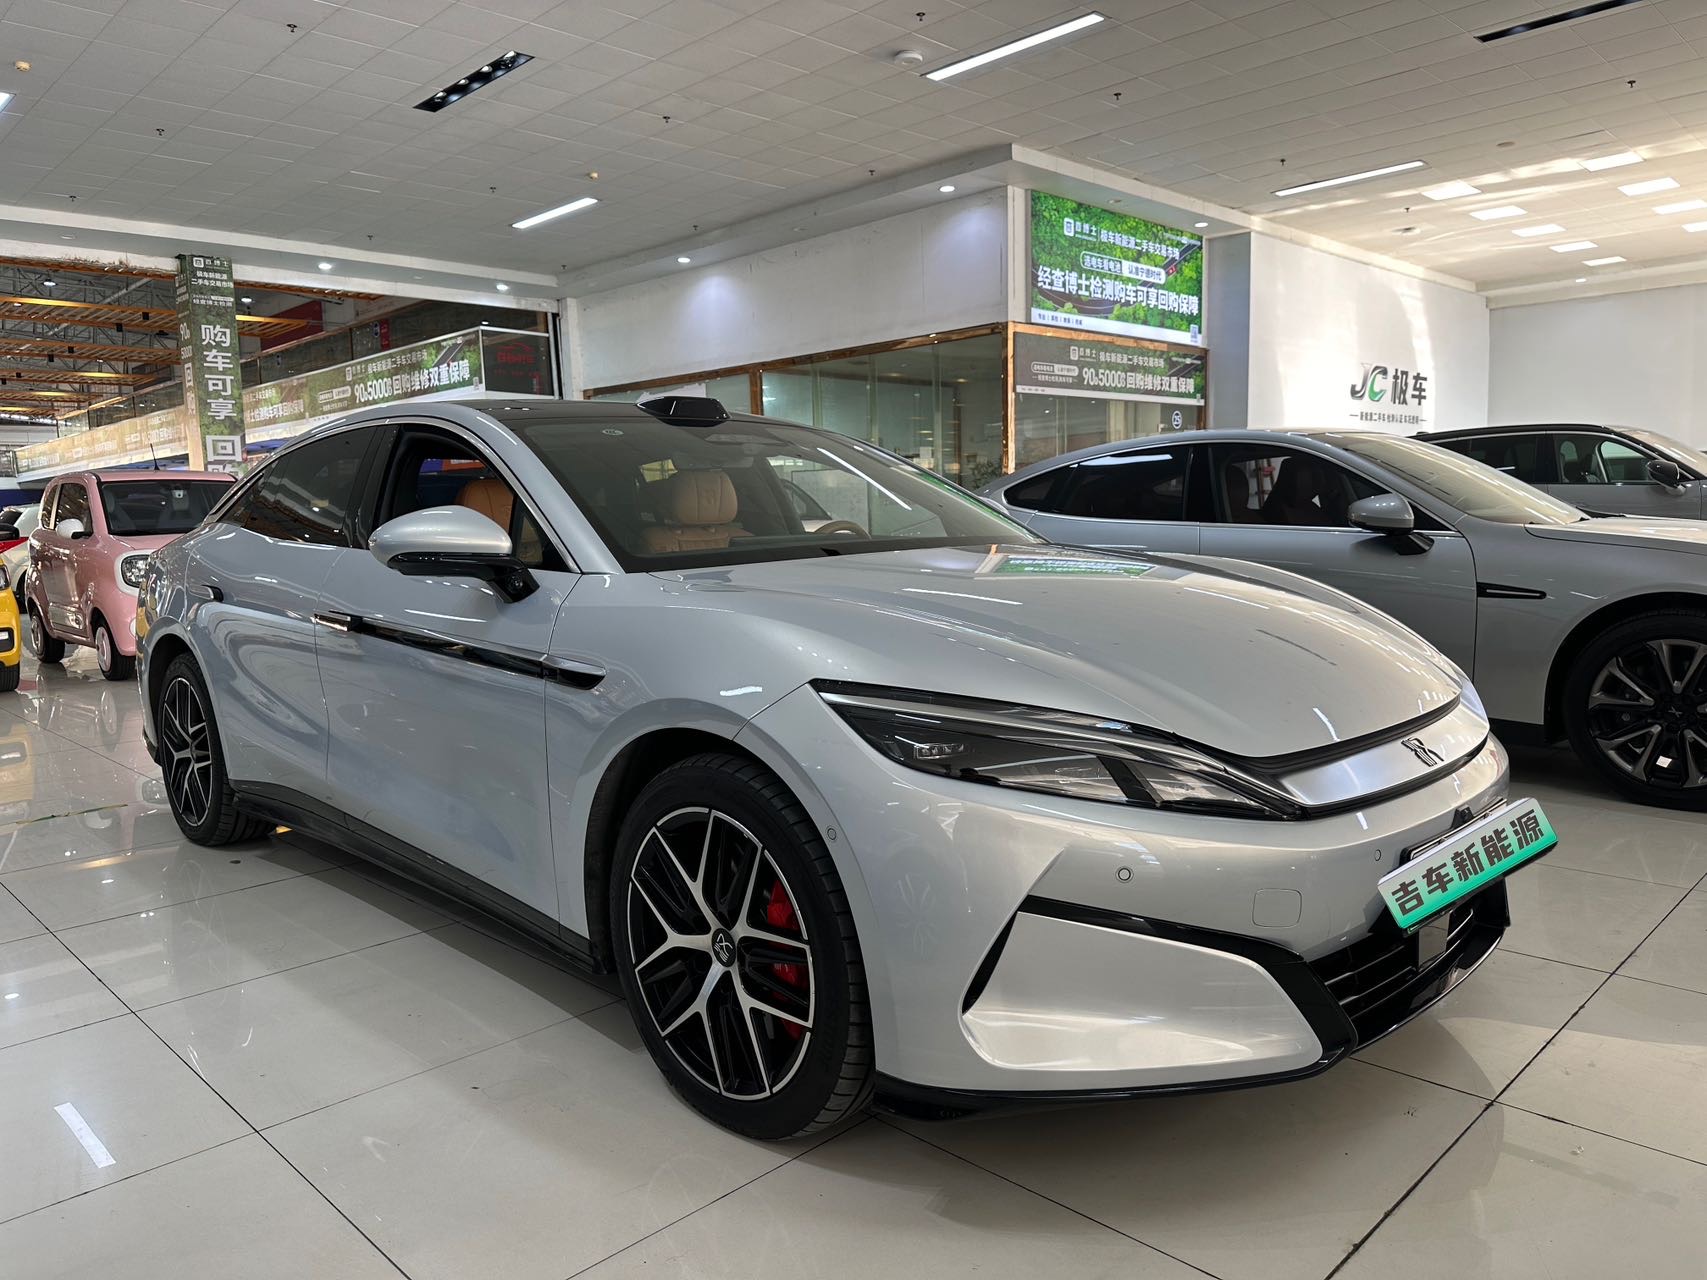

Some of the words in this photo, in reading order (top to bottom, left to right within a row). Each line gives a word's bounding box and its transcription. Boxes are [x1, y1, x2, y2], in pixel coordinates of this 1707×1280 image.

[1037, 265, 1199, 317] 经查博士检测购车可享回购保障
[201, 324, 237, 420] 购车可享
[1391, 368, 1428, 406] 极车
[1391, 808, 1545, 916] 吉车新能源
